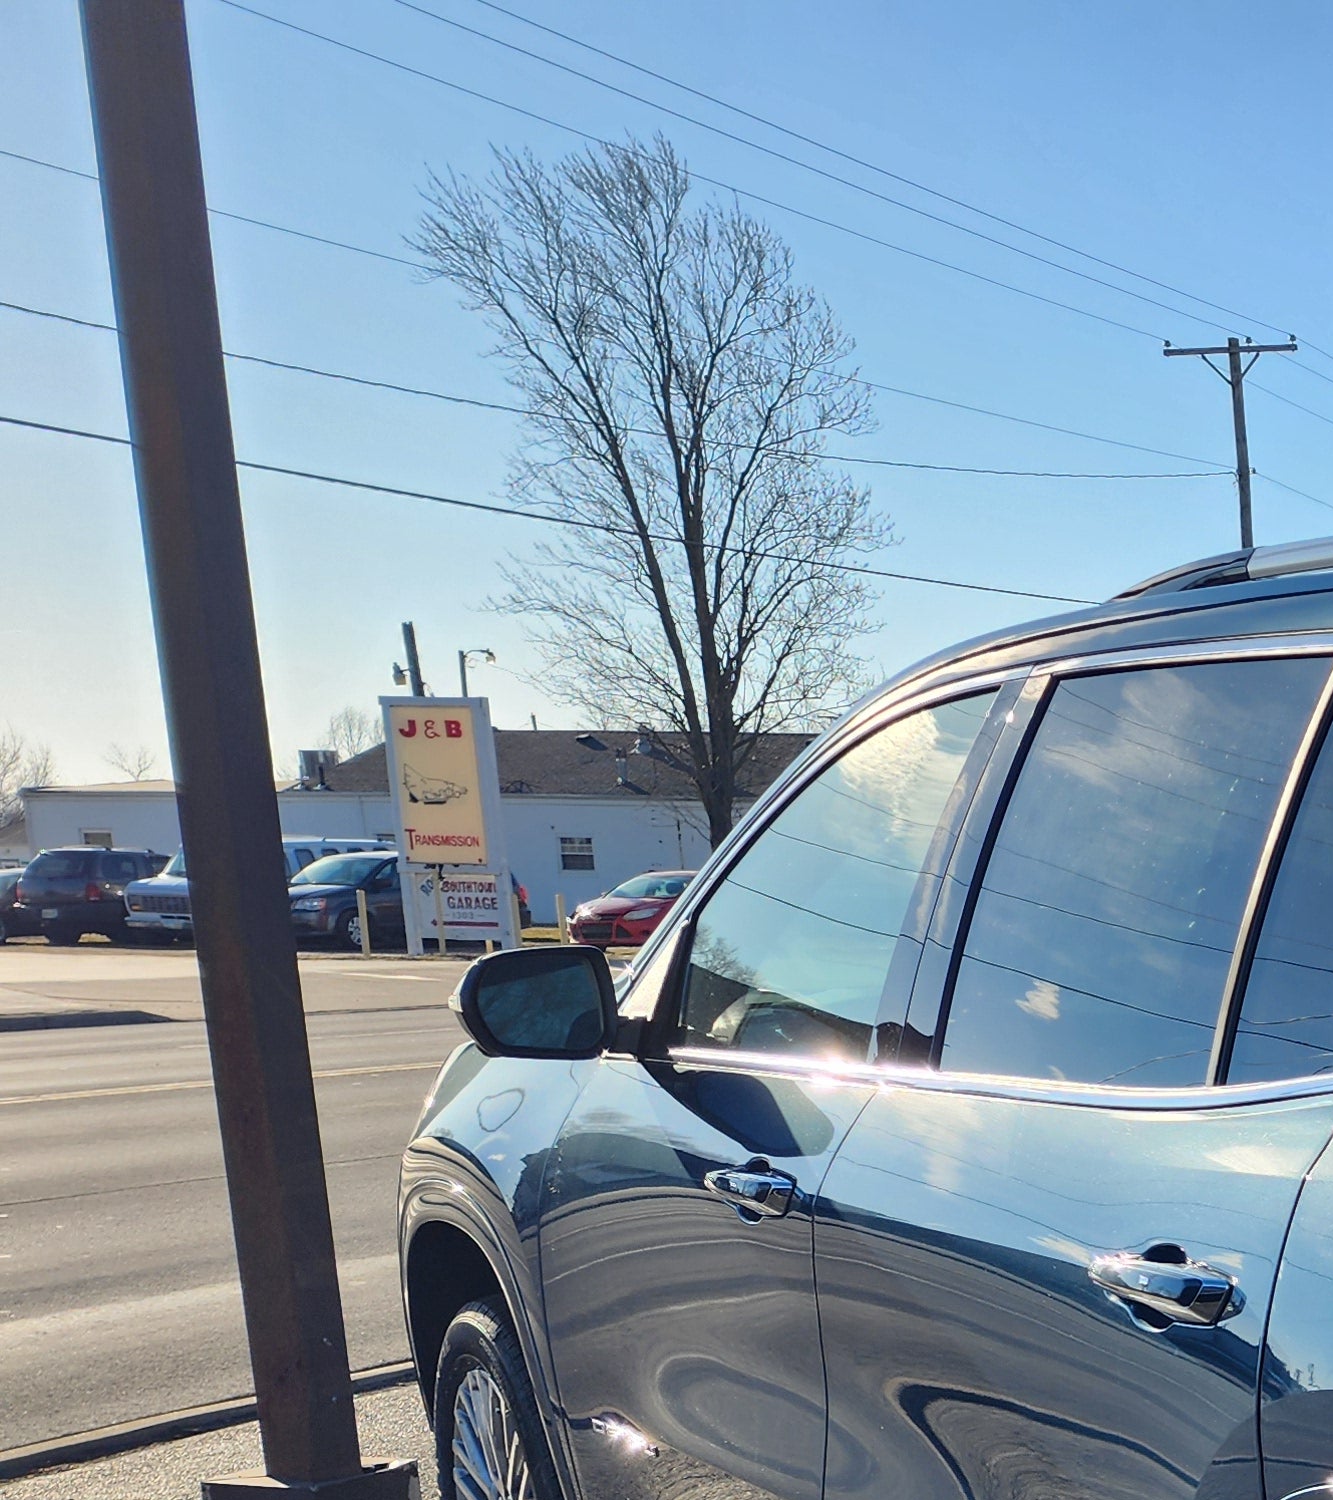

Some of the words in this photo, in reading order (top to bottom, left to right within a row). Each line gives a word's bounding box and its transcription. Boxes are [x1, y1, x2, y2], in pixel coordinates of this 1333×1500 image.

[398, 719, 417, 739] J
[424, 719, 440, 739] &
[444, 720, 463, 739] B
[404, 828, 480, 850] TRANSMISSION
[446, 895, 499, 911] GARAGE
